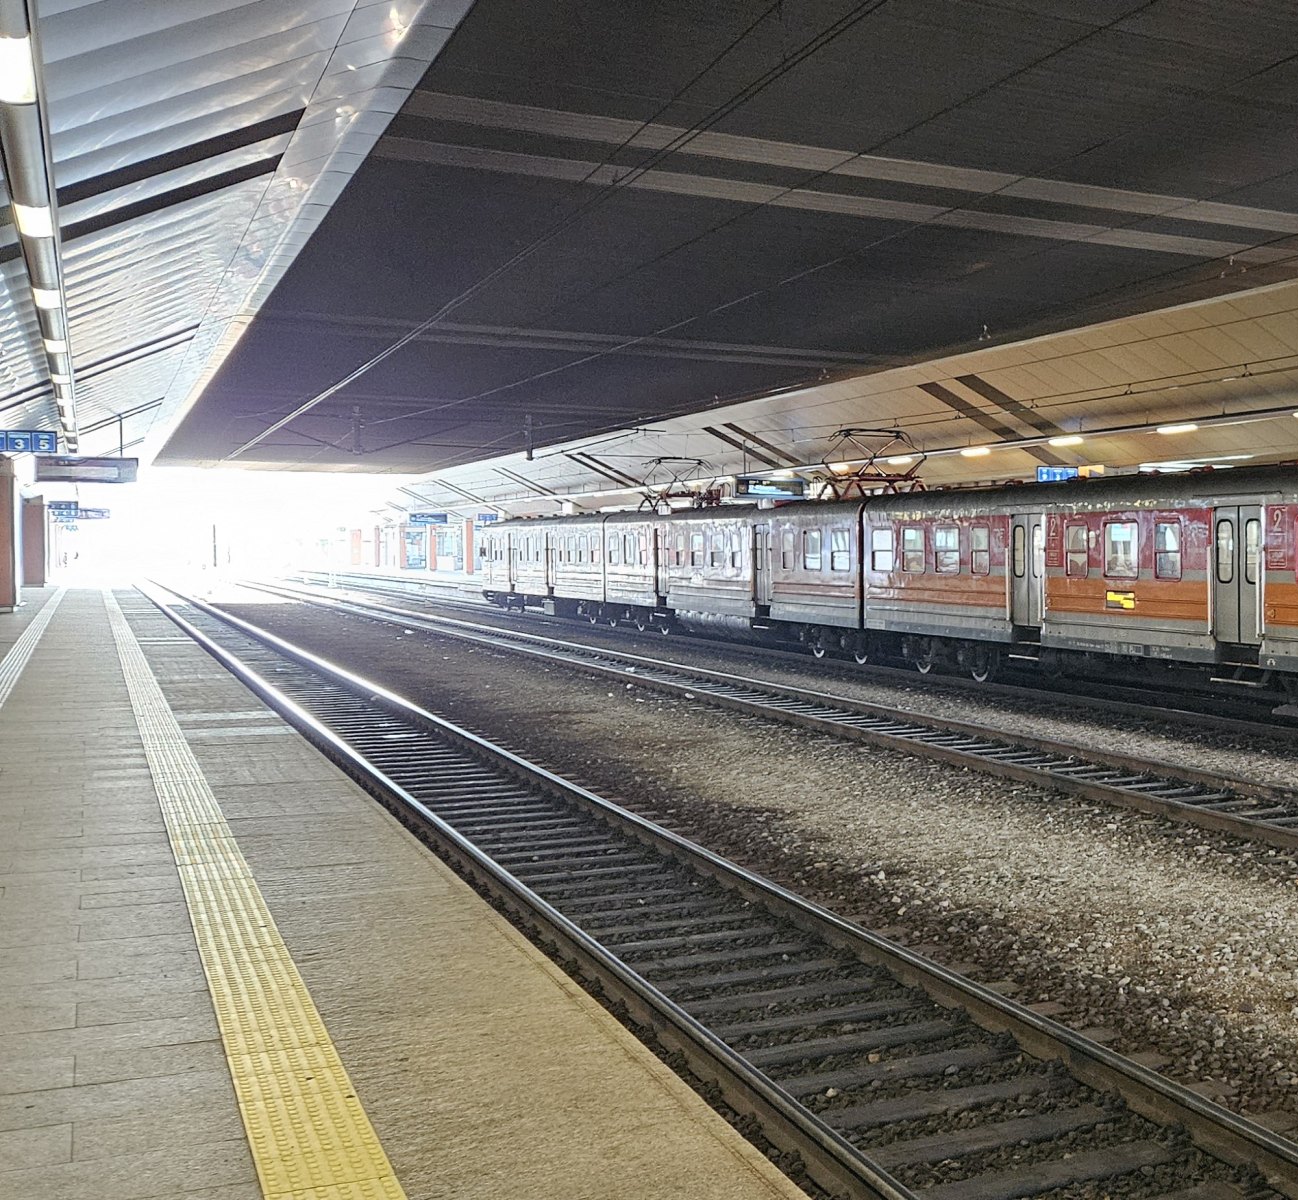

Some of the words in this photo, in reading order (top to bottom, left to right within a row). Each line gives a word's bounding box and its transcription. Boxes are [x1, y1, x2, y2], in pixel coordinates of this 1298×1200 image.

[14, 439, 25, 449] 3
[39, 439, 50, 450] 5
[1050, 518, 1056, 536] 2
[1273, 509, 1282, 531] 2
